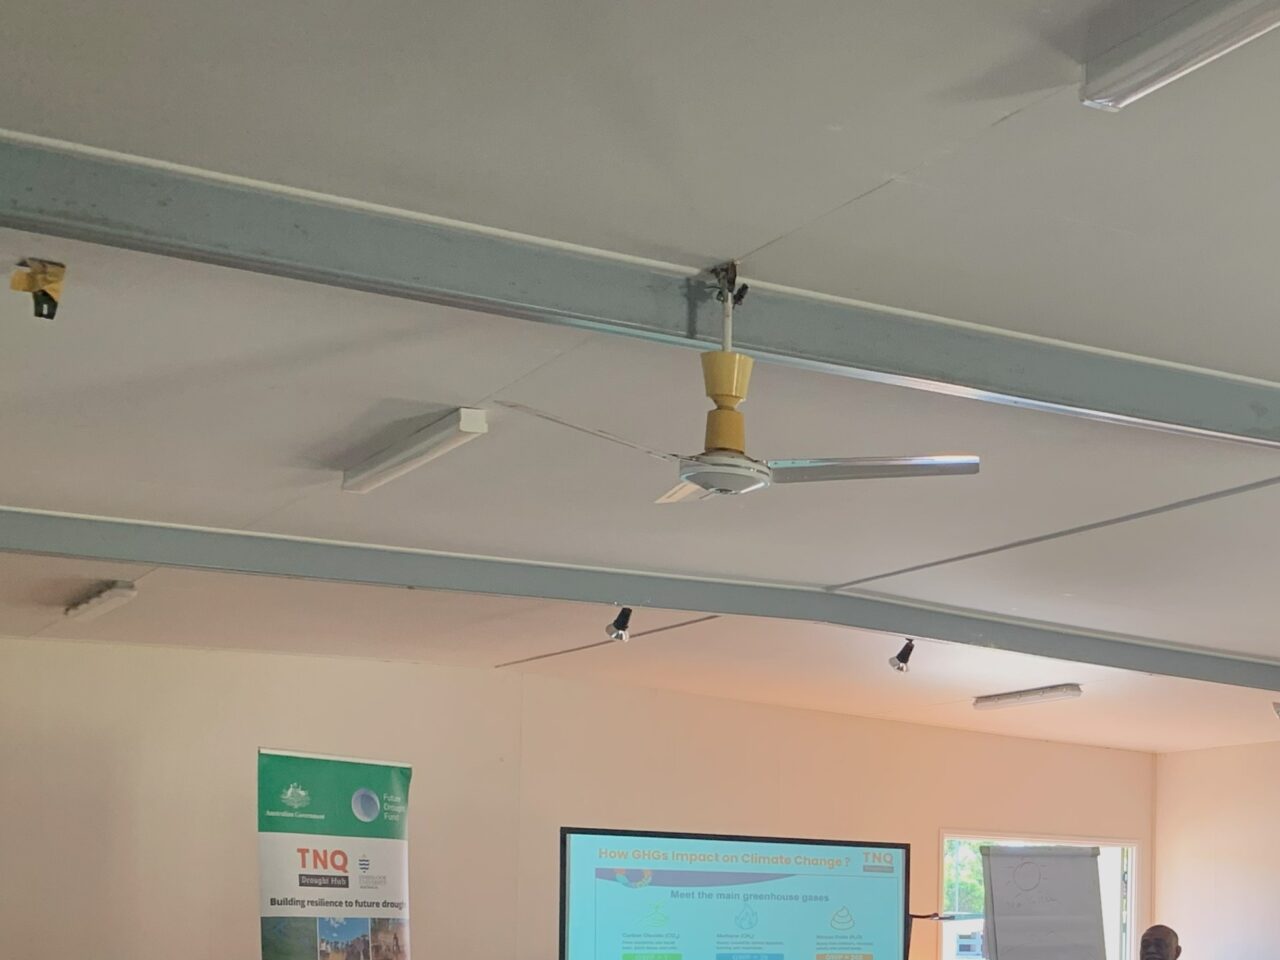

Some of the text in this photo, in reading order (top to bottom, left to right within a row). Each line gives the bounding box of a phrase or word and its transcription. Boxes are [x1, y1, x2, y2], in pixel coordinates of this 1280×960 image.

[297, 848, 349, 873] TNQ
[598, 848, 627, 859] How
[632, 849, 668, 860] GHGs
[672, 851, 719, 864] Impact
[722, 853, 738, 863] on
[741, 853, 791, 865] Climate
[794, 855, 842, 869] Change
[863, 852, 894, 865] TNQ
[301, 876, 347, 886] Drought Hub
[270, 897, 306, 909] Building
[307, 898, 343, 908] resilience
[345, 900, 353, 908] to
[355, 899, 380, 908] future
[670, 890, 829, 903] Meet the main greenhouse gases
